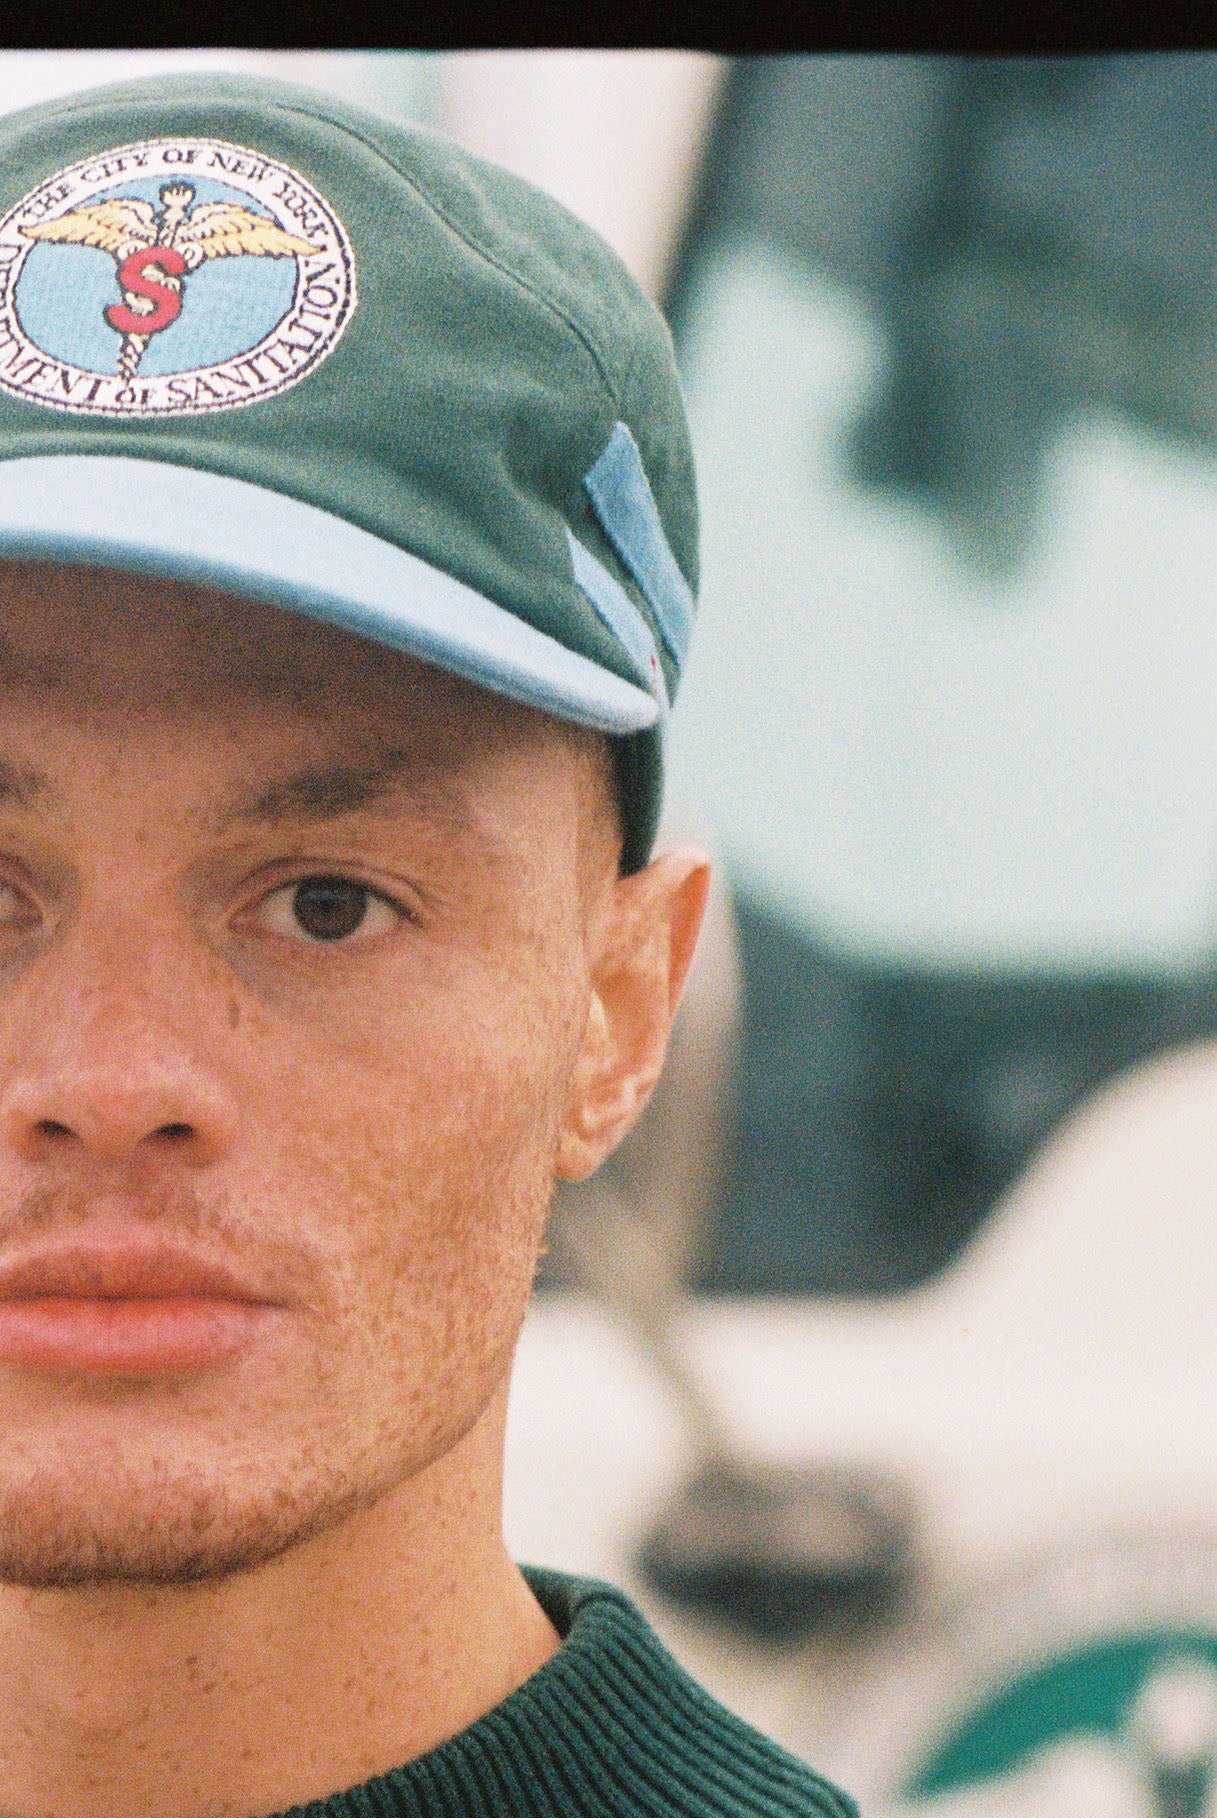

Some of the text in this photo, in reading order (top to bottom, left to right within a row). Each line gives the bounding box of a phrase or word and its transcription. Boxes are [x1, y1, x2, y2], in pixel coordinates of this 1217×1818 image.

[22, 148, 329, 239] THE CITY OF NEW YORK
[166, 258, 338, 405] SANITATION
